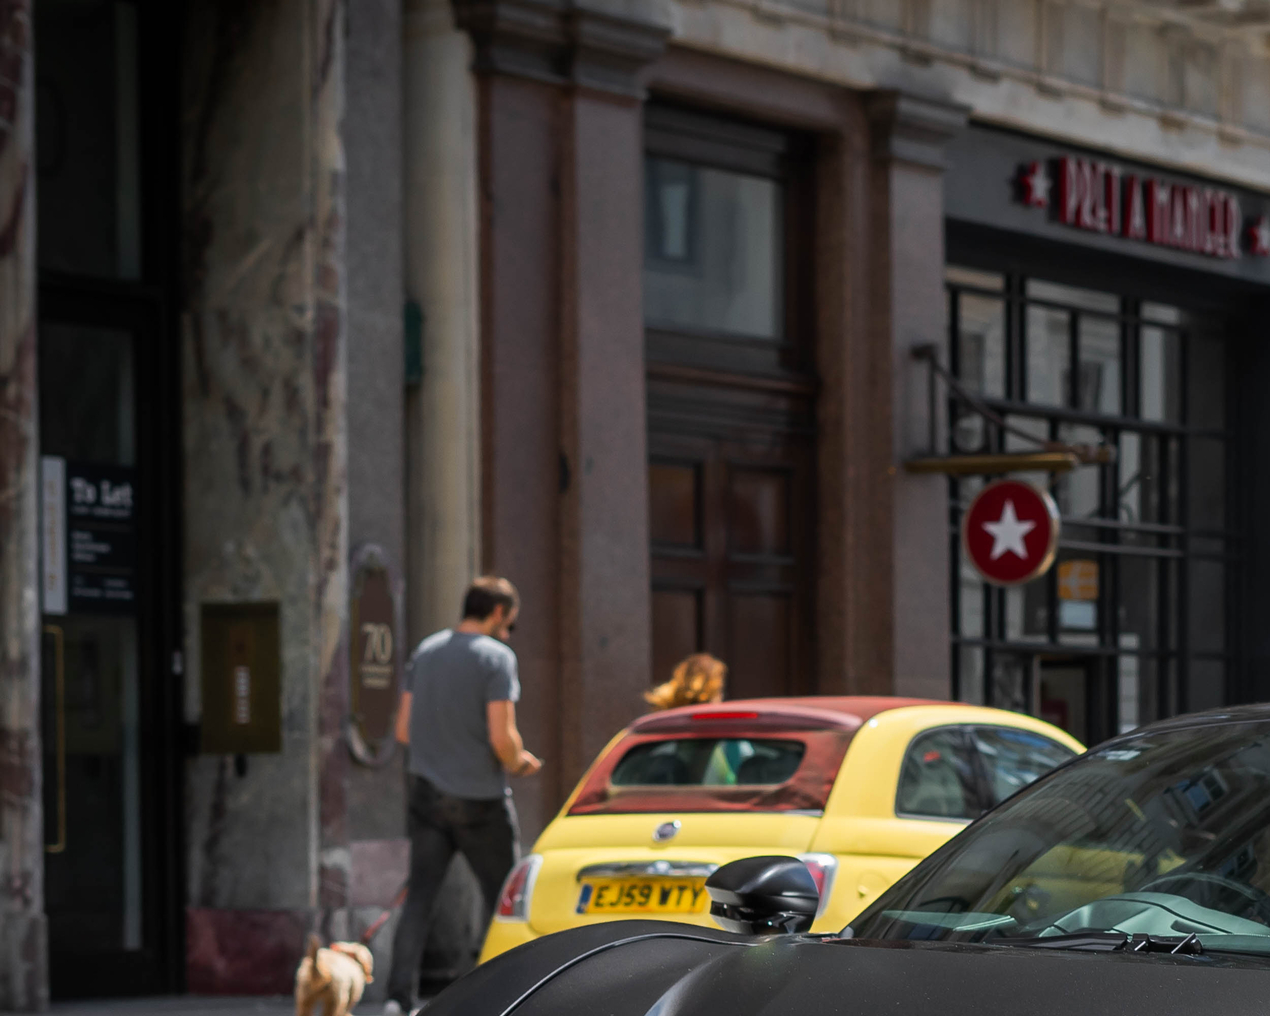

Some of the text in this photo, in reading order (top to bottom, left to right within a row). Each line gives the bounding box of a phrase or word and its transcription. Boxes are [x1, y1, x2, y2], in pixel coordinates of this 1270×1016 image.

[1059, 155, 1242, 260] PRET A MANGER
[361, 622, 393, 664] 70
[594, 885, 704, 908] EJ59 WTY
